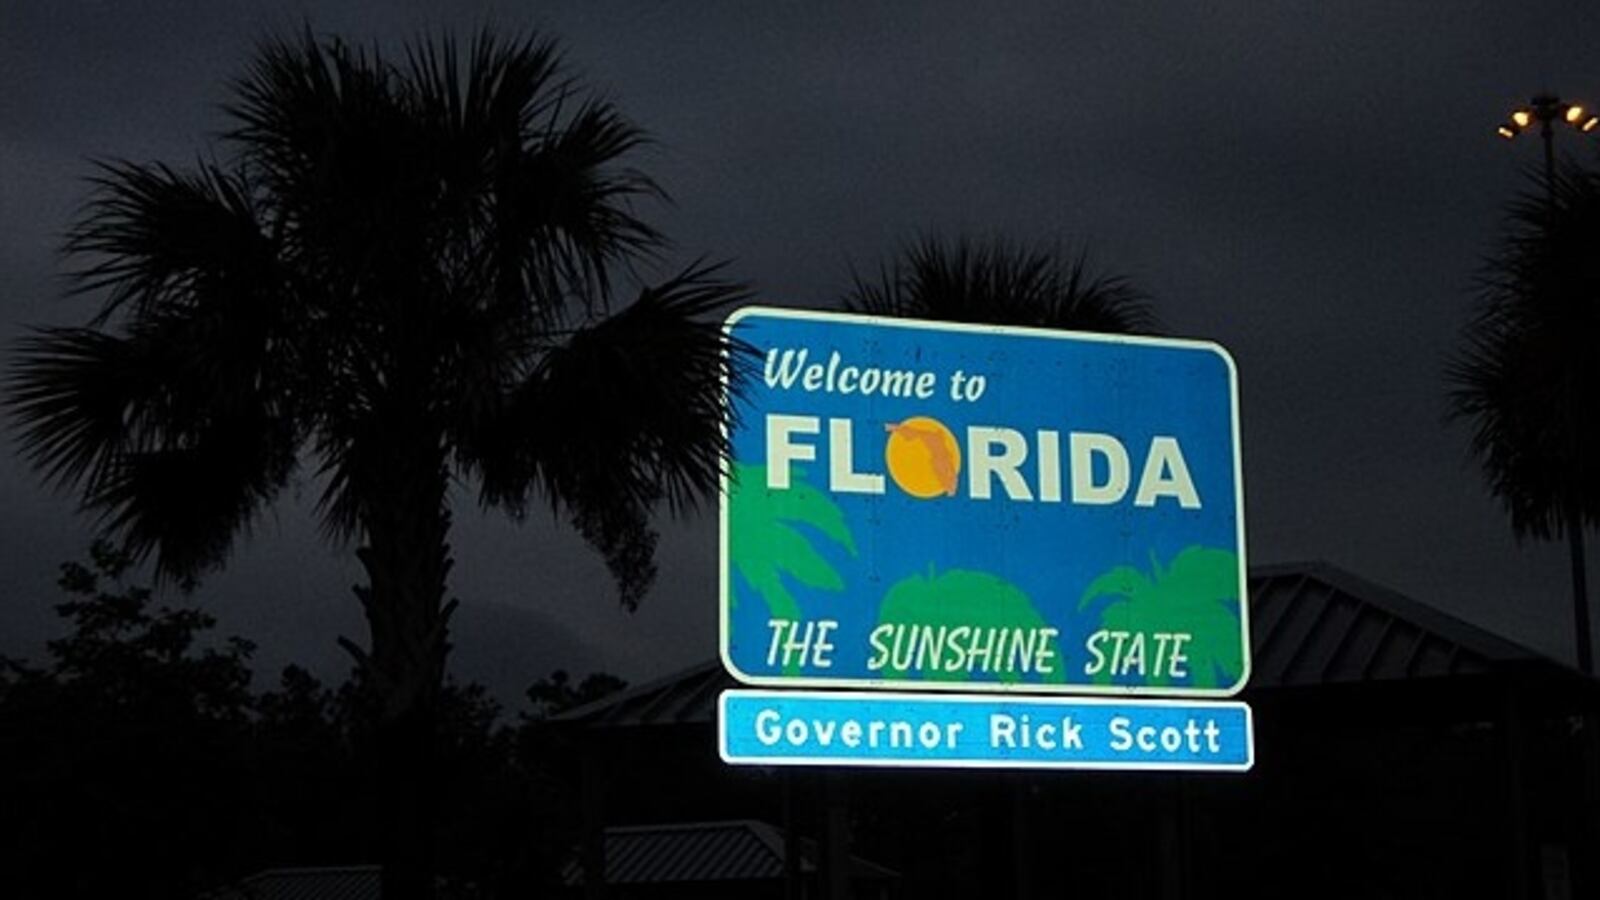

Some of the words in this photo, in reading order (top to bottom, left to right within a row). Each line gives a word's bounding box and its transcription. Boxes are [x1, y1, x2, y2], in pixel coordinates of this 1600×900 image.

[764, 347, 935, 398] Welcome
[950, 369, 987, 402] to
[765, 413, 1202, 509] FLORIDA
[766, 619, 839, 668] THE
[867, 623, 1059, 673] SUNSHINE
[1084, 629, 1192, 678] STATE
[755, 710, 964, 749] Governor
[990, 714, 1084, 751] Rick
[1109, 717, 1221, 753] Scott
